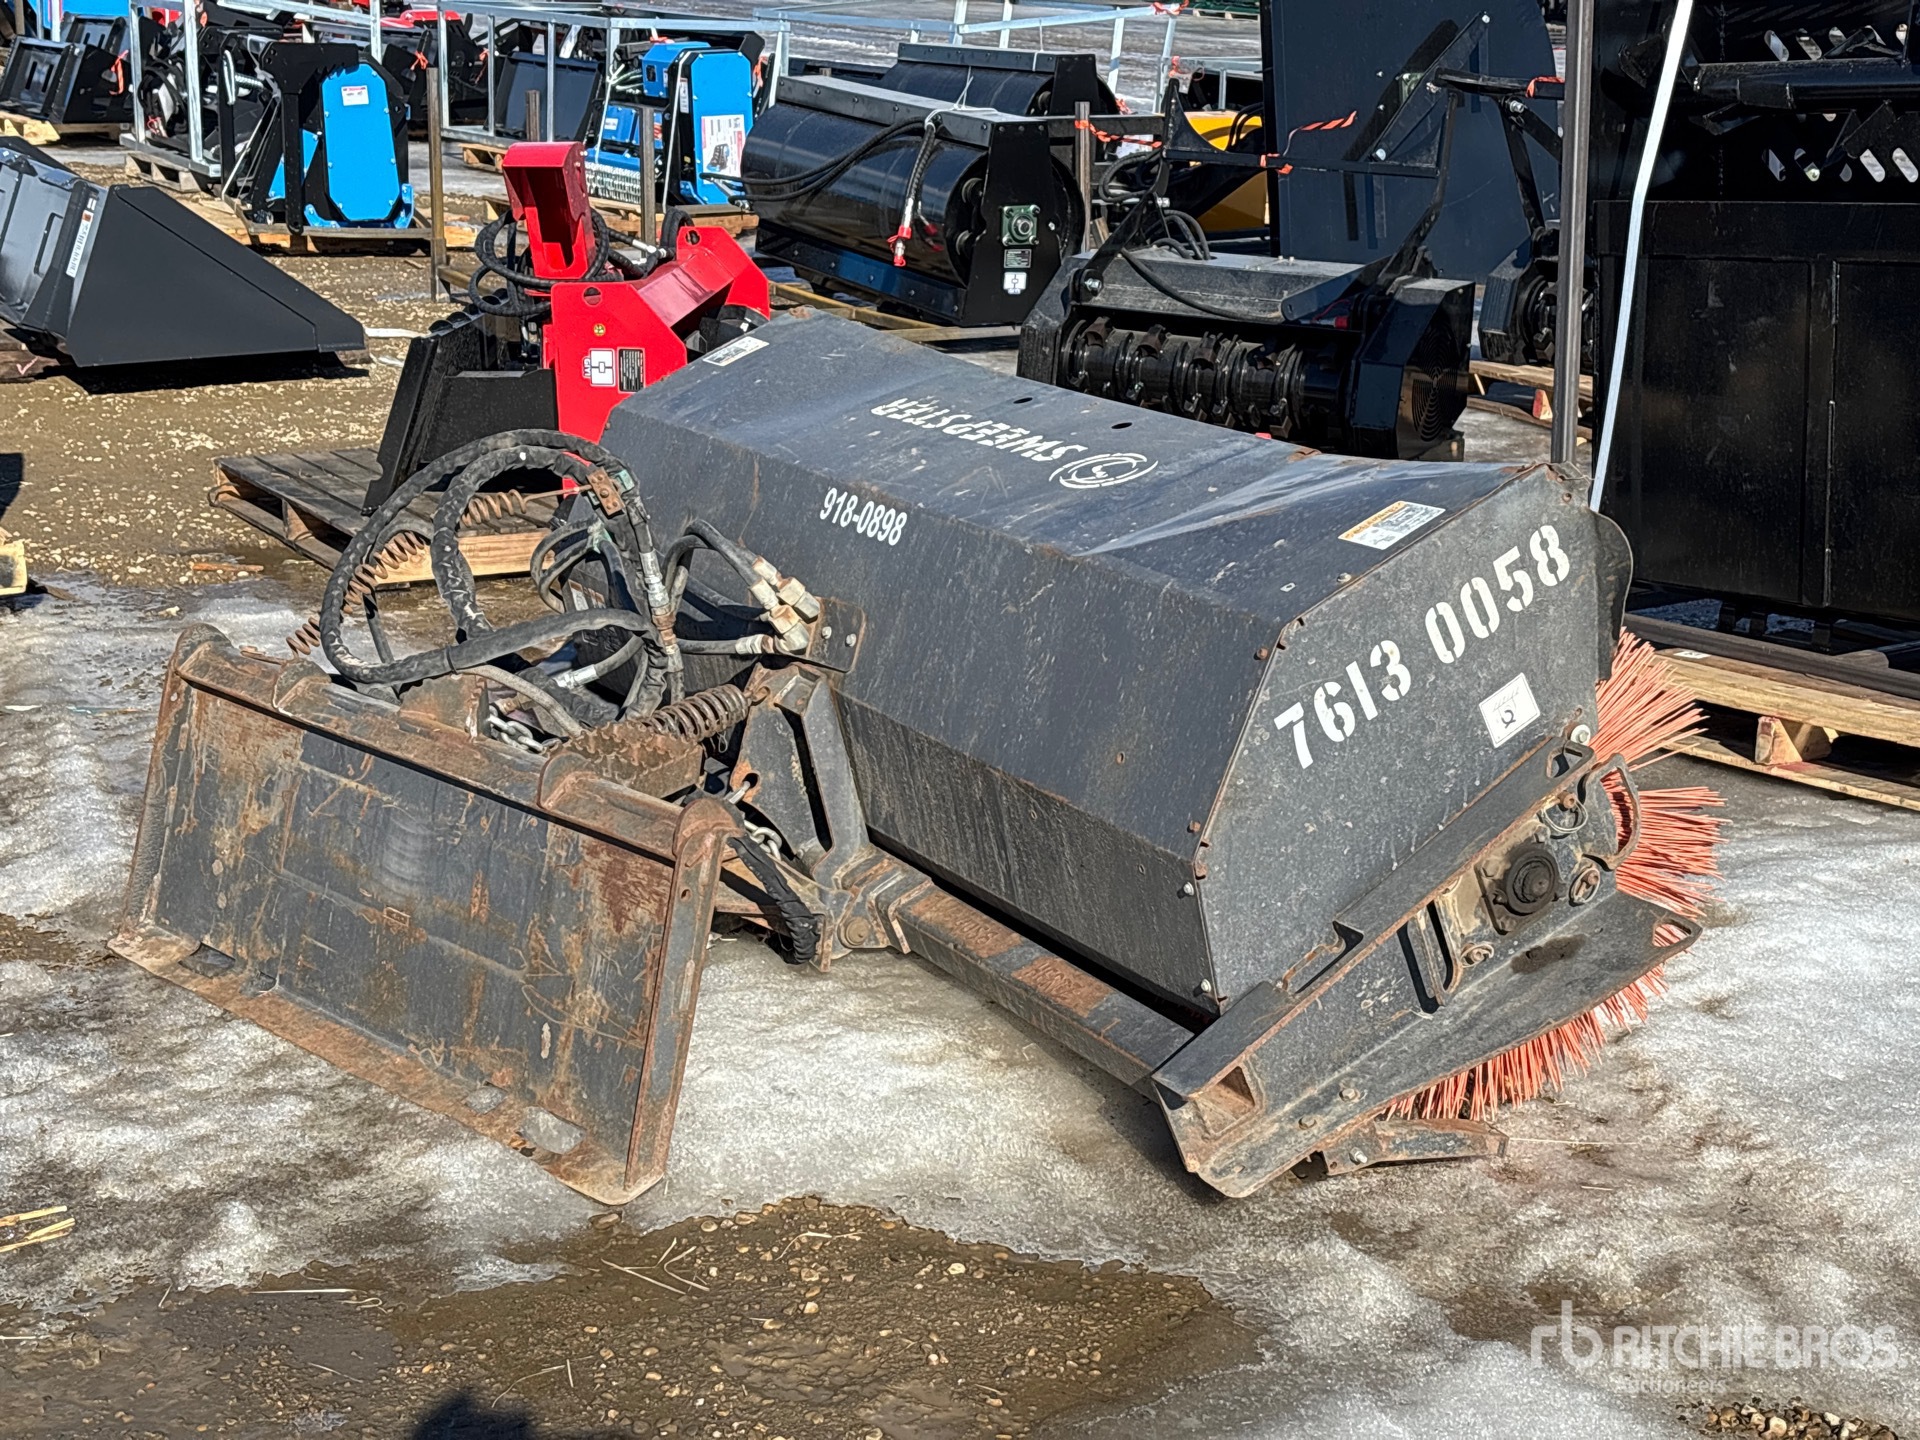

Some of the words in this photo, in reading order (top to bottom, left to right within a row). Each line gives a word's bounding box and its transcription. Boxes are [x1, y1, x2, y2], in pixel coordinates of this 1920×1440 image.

[870, 397, 1088, 461] SWEEPSTER
[819, 487, 908, 546] 918-0898
[1424, 525, 1571, 664] 0058
